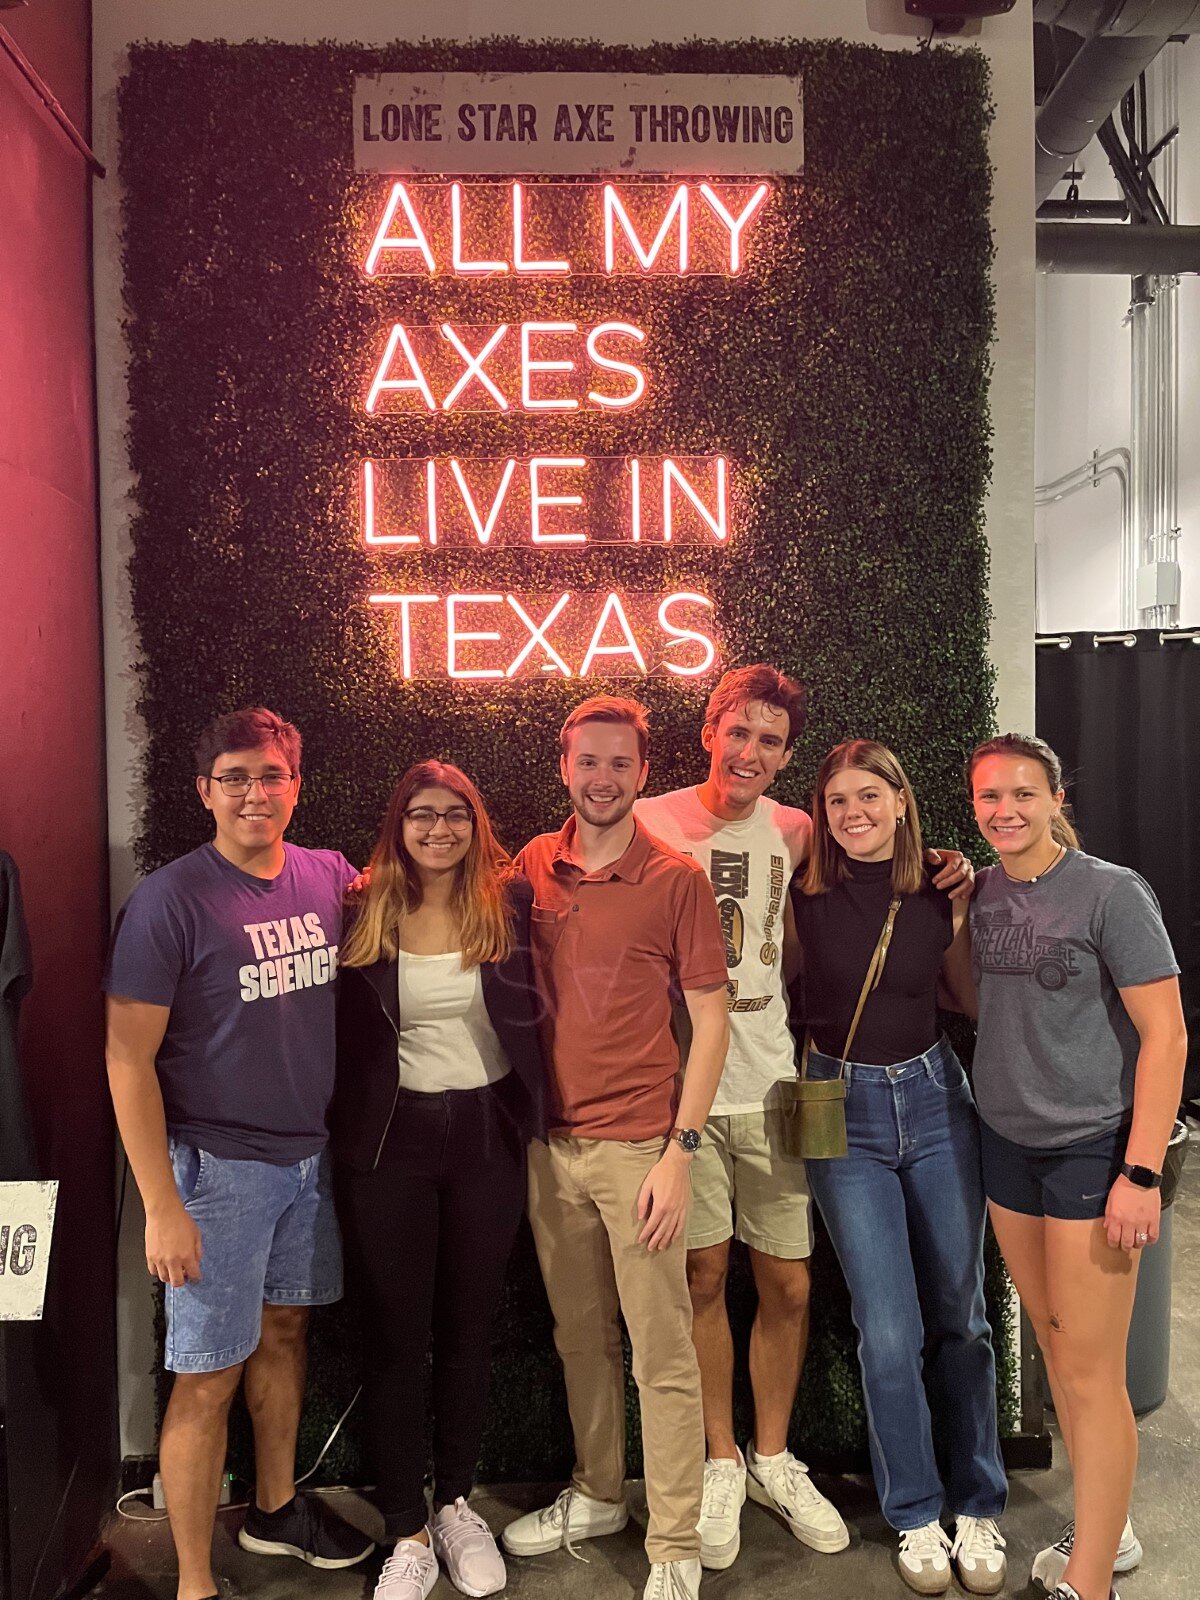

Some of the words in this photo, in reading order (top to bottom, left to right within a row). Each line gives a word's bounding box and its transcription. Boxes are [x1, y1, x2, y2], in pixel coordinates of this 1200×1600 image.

[363, 104, 442, 142] LONE
[457, 104, 537, 142] STAR
[553, 104, 615, 142] AXE
[629, 105, 794, 144] THROWING
[364, 182, 570, 275] ALL
[604, 182, 769, 275] MY
[364, 321, 647, 412] AXES
[364, 458, 586, 545] LIVE
[630, 457, 728, 542] IN
[369, 592, 716, 679] TEXAS
[243, 912, 327, 960] TEXAS
[760, 855, 784, 967] SUPREME
